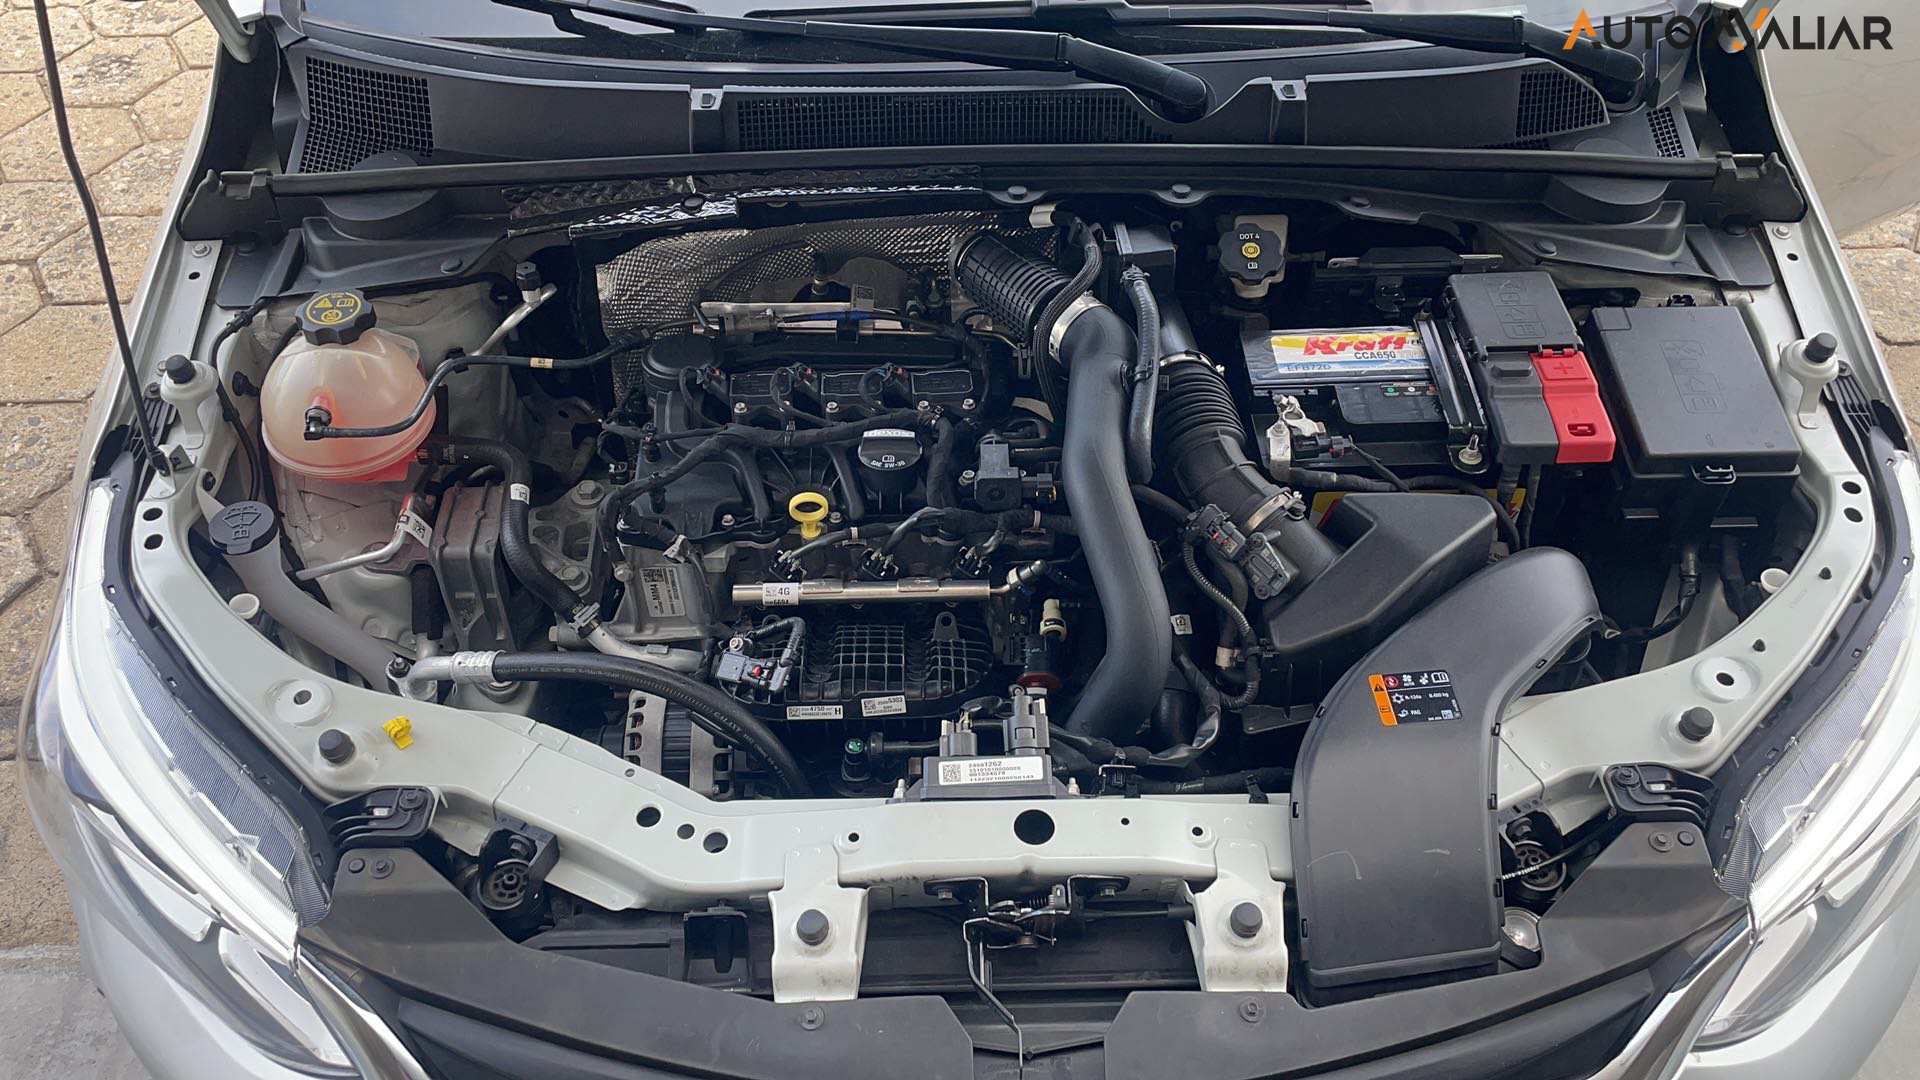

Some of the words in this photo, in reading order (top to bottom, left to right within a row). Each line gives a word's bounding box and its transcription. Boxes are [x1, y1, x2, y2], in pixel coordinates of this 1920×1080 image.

[1303, 335, 1408, 356] Kraft
[1354, 351, 1396, 360] CCA650
[777, 587, 790, 596] 4G
[835, 707, 841, 715] H
